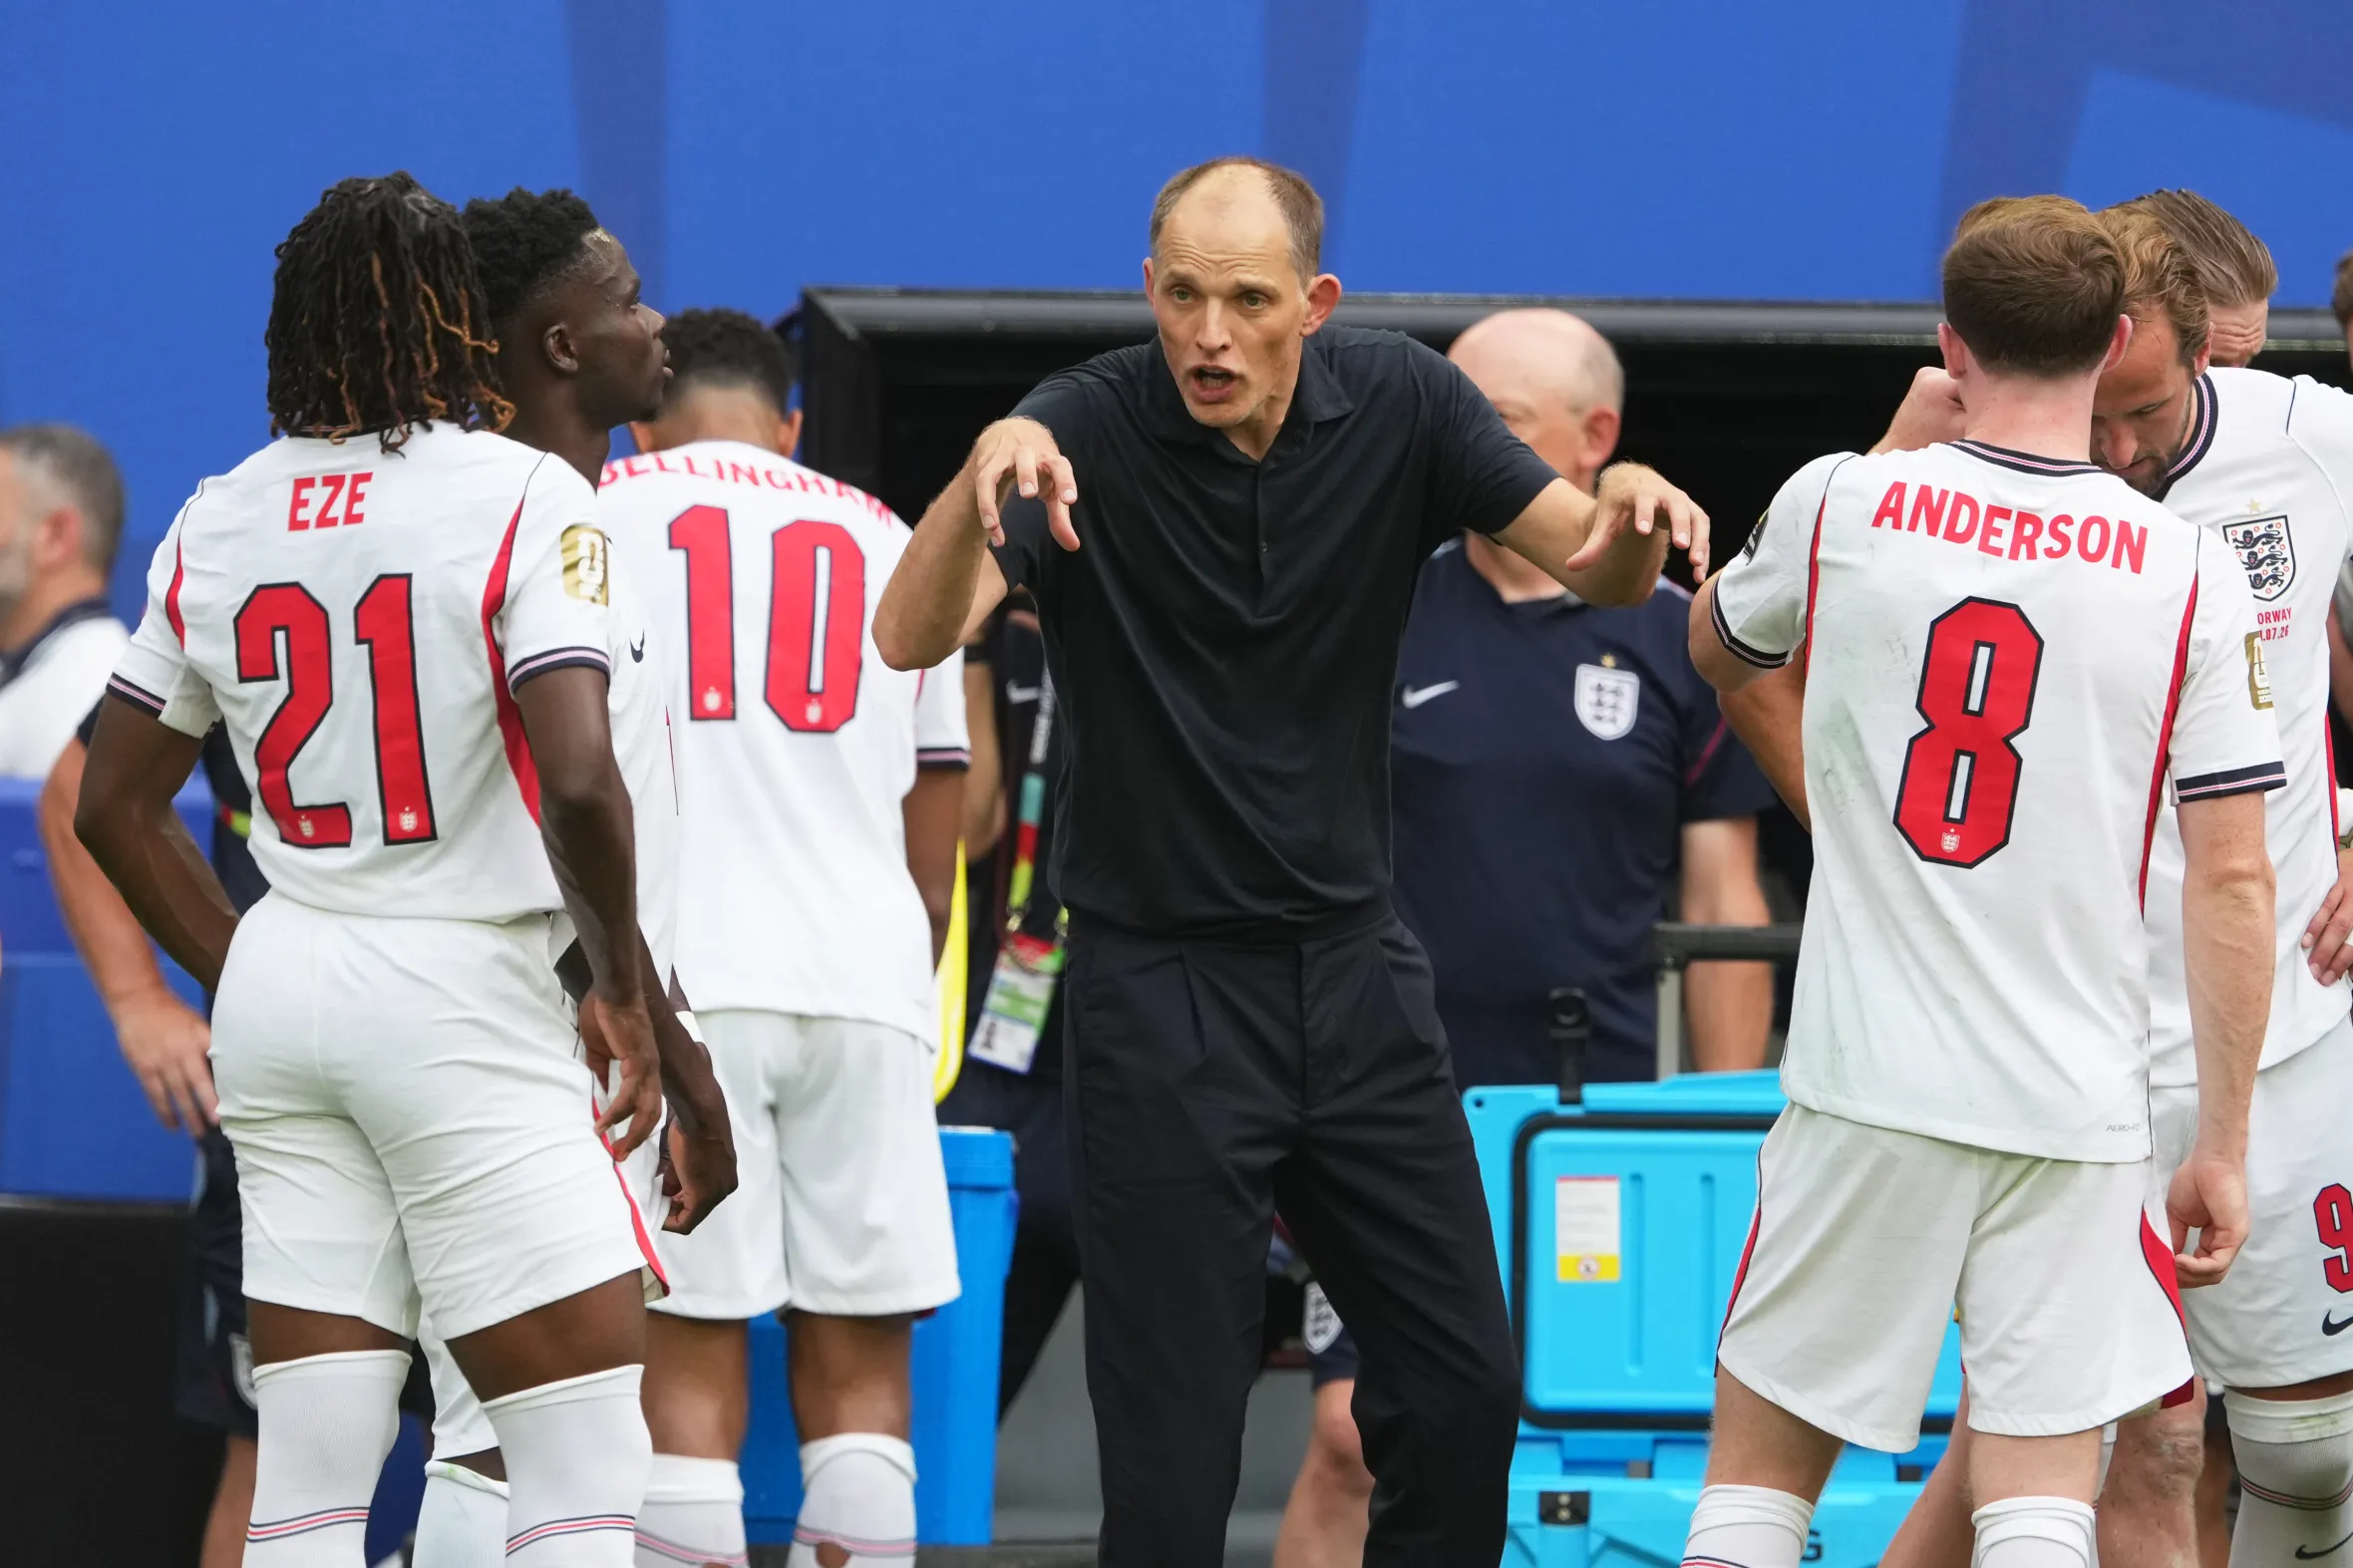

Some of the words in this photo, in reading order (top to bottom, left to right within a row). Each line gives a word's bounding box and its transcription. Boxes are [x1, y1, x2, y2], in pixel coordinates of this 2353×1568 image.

[288, 472, 373, 531] EZE
[1871, 481, 2148, 574] ANDERSON
[668, 504, 865, 733] 10
[2257, 607, 2291, 625] ORWAY
[233, 573, 438, 848] 21
[1893, 595, 2045, 869] 8
[2313, 1183, 2353, 1294] 9
